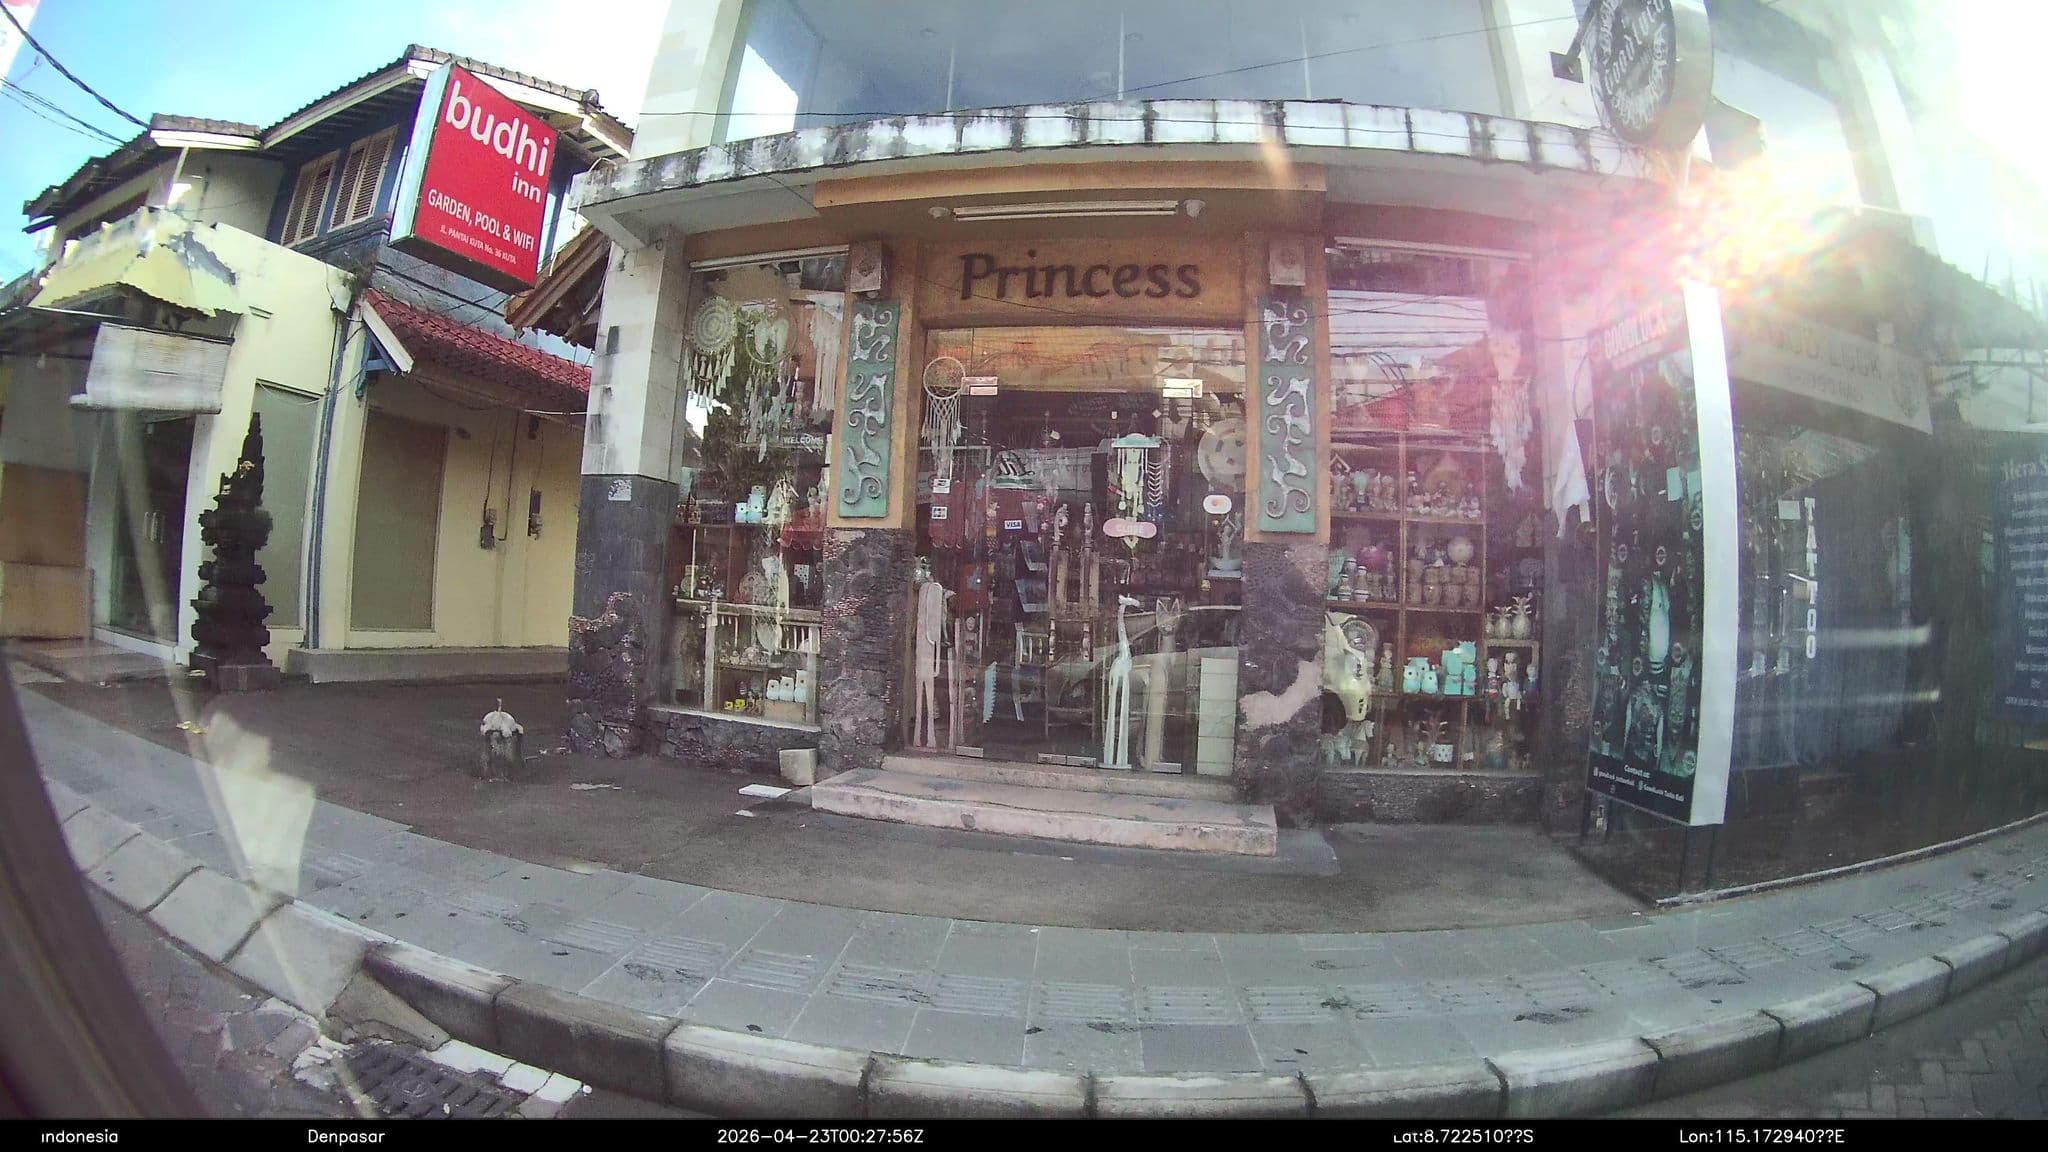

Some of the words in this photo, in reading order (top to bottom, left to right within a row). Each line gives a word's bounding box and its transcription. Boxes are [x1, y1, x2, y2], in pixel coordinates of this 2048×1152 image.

[445, 80, 550, 177] budhi
[512, 171, 541, 203] inn
[428, 188, 473, 227] GARDEN,
[474, 211, 501, 237] POOL
[502, 224, 511, 242] &
[513, 228, 535, 252] WIFI
[448, 228, 469, 244] PANTAI
[469, 237, 484, 250] KUTA
[502, 251, 517, 265] KUTA
[960, 249, 1202, 300] Princess
